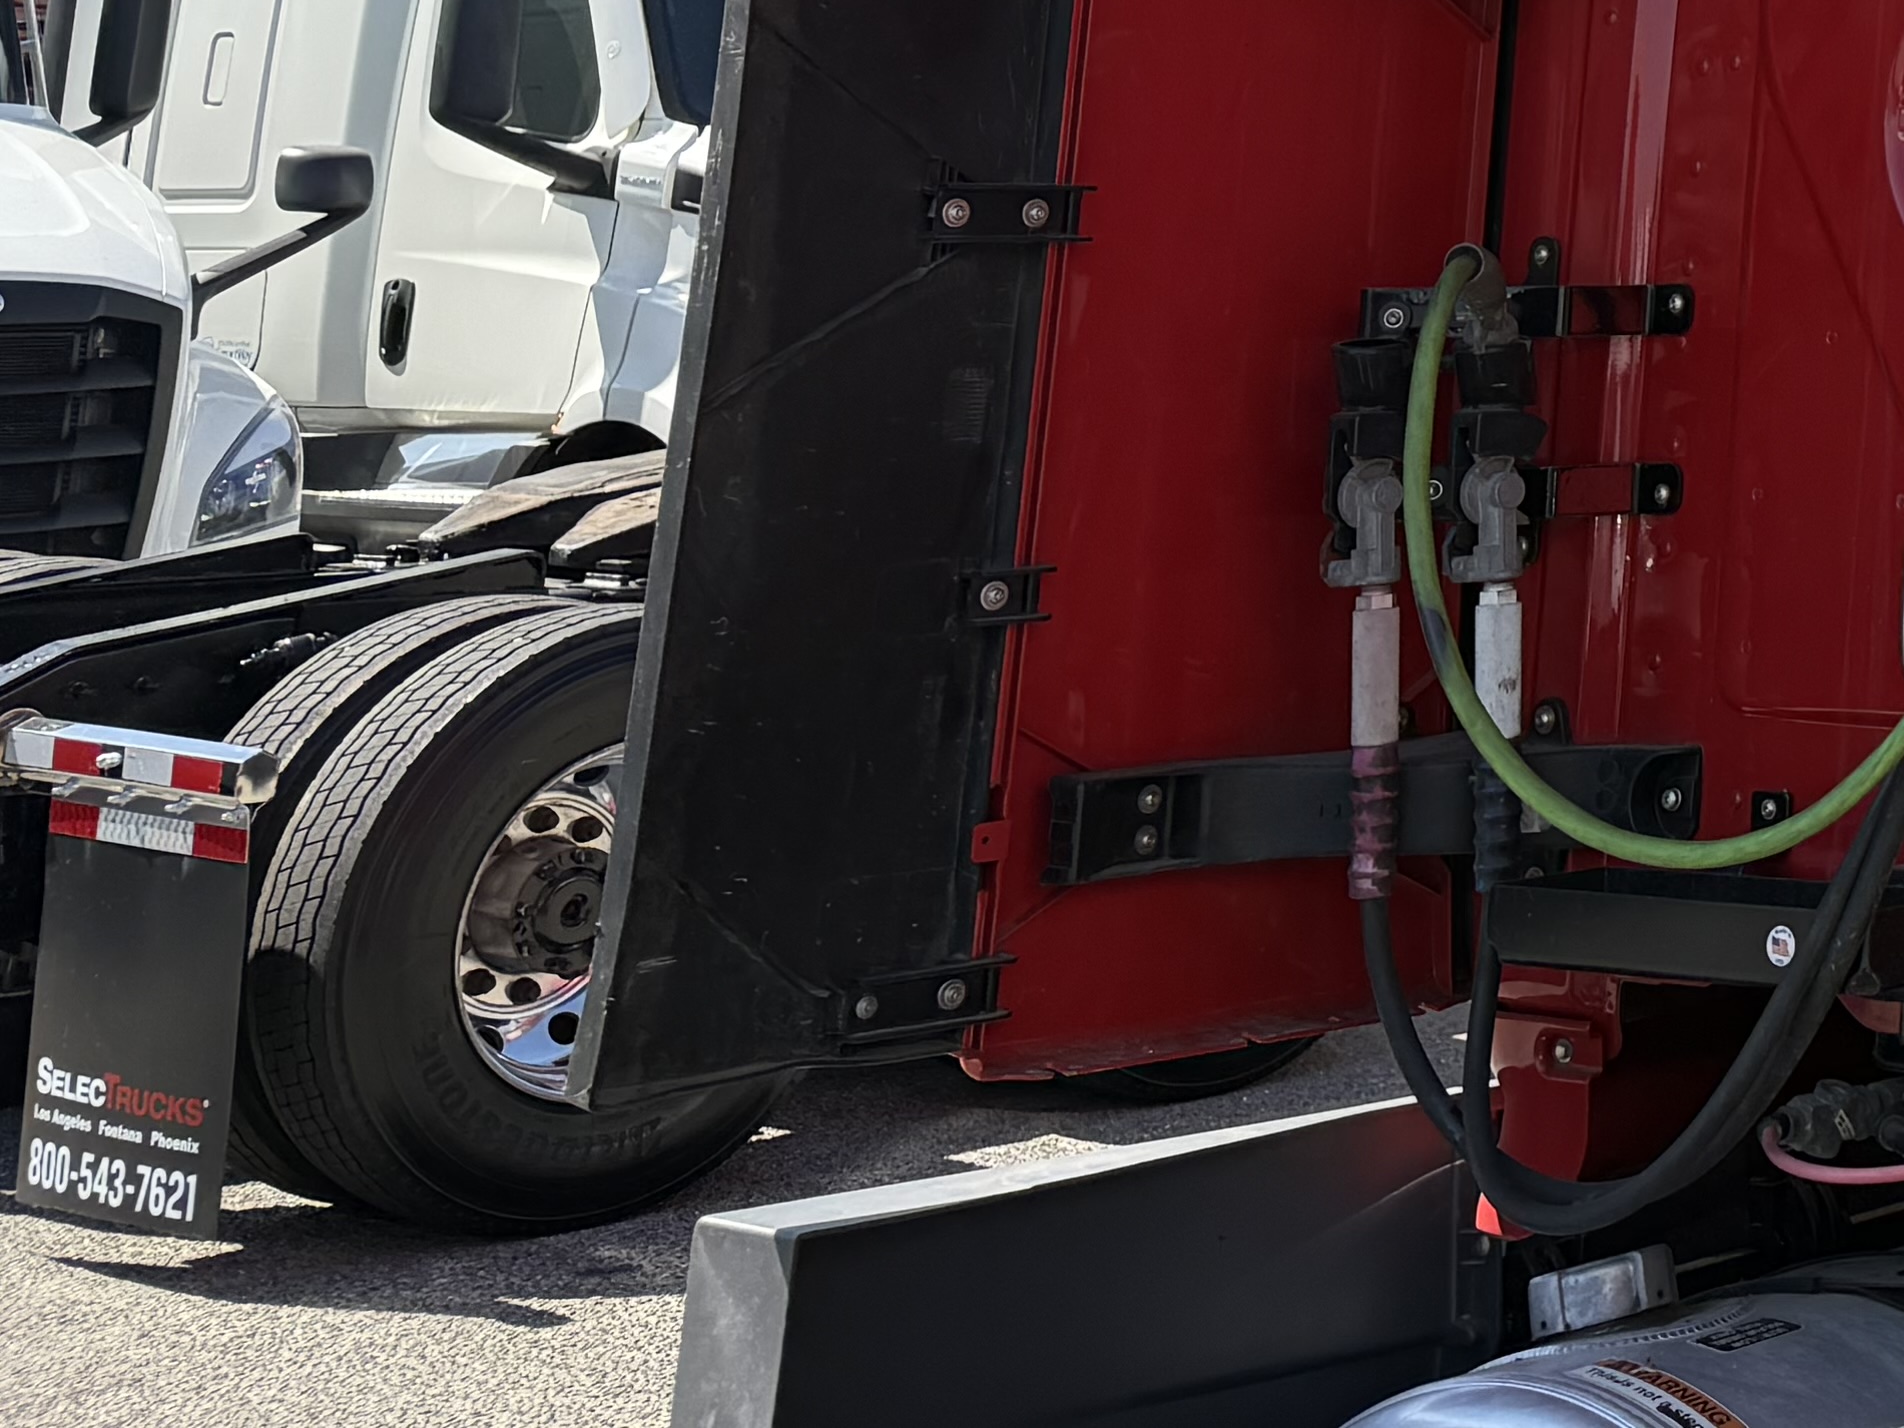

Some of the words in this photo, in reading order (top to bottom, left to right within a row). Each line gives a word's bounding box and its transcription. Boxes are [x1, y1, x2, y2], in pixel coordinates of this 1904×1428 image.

[33, 1103, 51, 1121] Los
[52, 1108, 92, 1132] Angeles
[98, 1119, 143, 1144] Fontana
[150, 1130, 200, 1154] Phoenix
[27, 1137, 198, 1222] 800-543-7621
